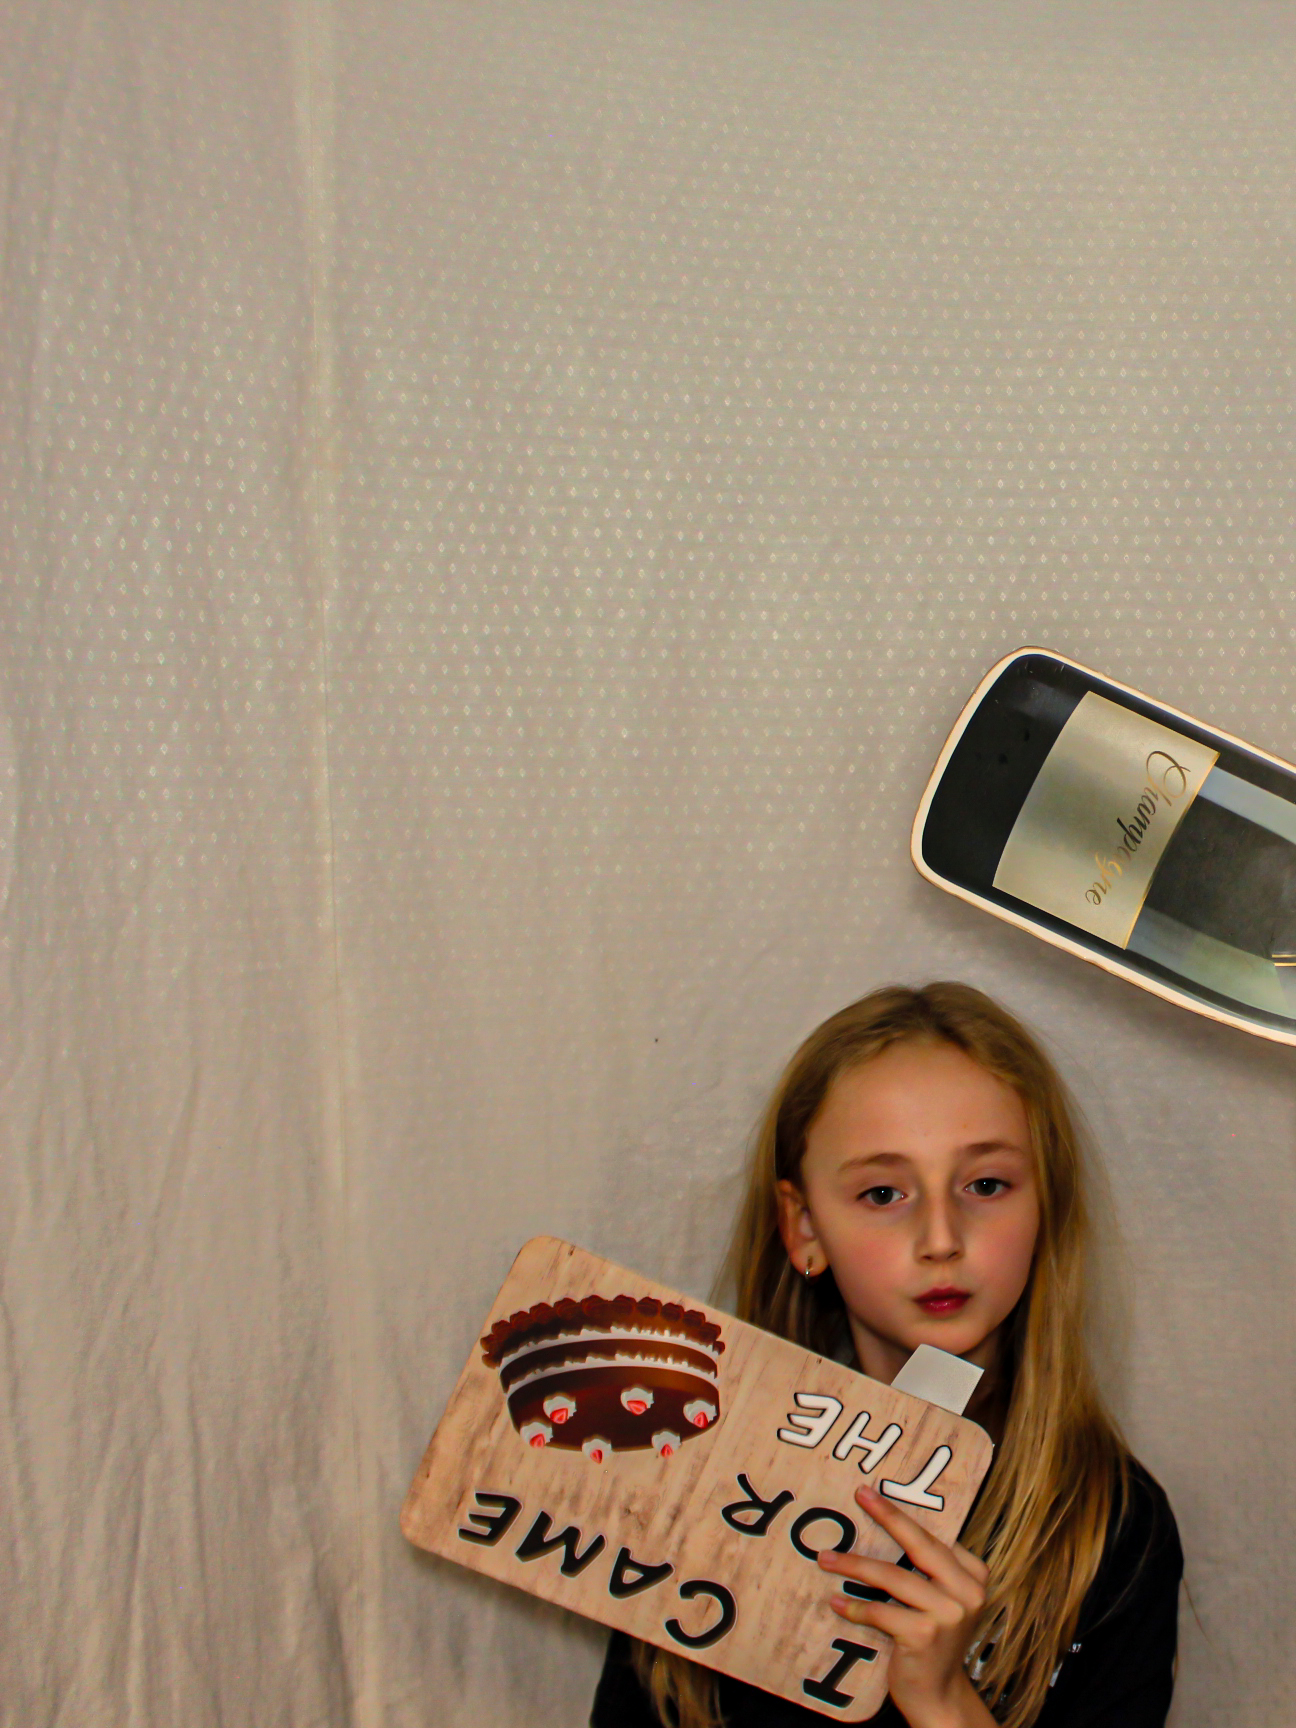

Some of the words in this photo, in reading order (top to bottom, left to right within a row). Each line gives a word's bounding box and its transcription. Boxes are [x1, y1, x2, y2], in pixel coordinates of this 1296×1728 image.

[1084, 750, 1191, 906] Champagne
[777, 1391, 953, 1512] THE
[457, 1490, 738, 1650] CAME
[802, 1637, 879, 1709] I
